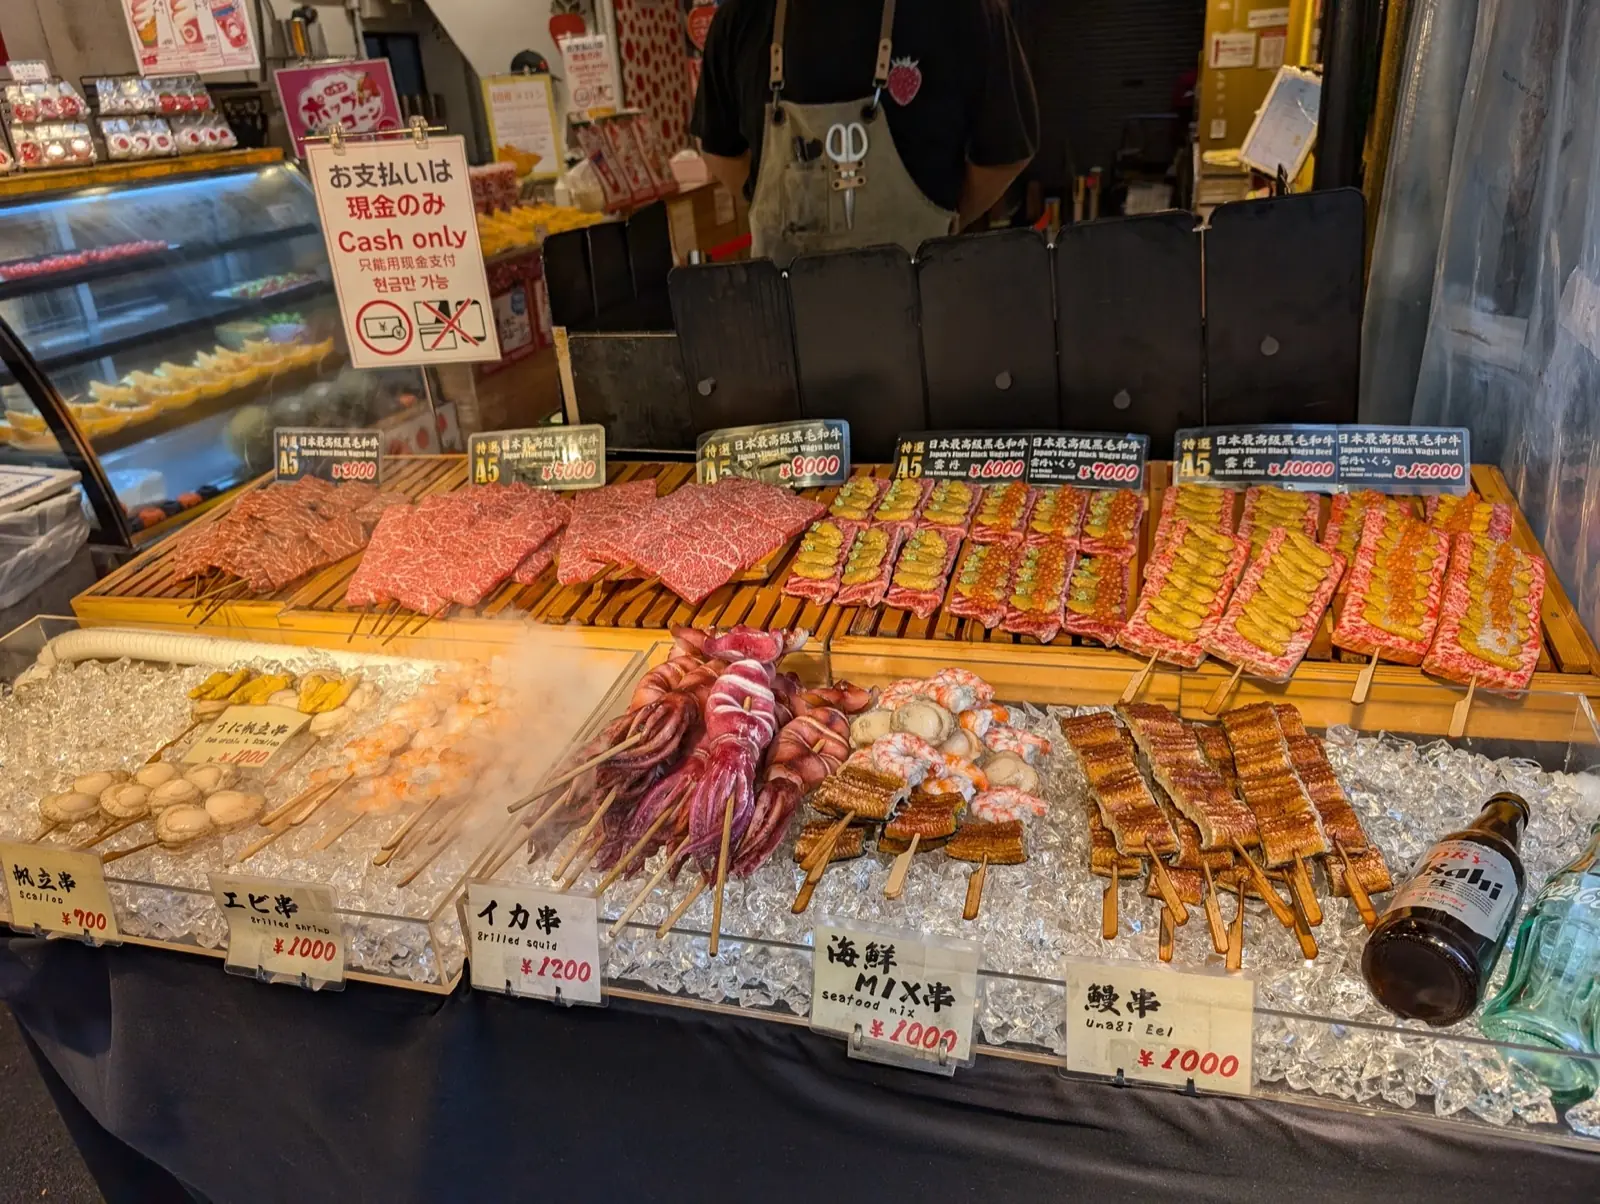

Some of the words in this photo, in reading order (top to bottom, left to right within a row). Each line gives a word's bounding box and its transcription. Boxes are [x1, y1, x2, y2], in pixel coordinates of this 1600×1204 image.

[329, 159, 453, 189] お支払いは
[346, 192, 446, 221] 現金のみ
[338, 227, 403, 253] Cash
[412, 225, 468, 249] only
[358, 253, 457, 272] 只能用现金支付
[372, 275, 416, 293] 현금만
[420, 274, 450, 290] 가능
[705, 443, 732, 458] 特選
[734, 427, 842, 451] 日本最高級黒毛和牛
[929, 437, 1028, 450] 日本最高級黒毛和牛
[1033, 437, 1141, 451] 日本最高級黒毛和牛
[1182, 437, 1212, 450] 特選
[1216, 434, 1336, 447] 日本最高級黒毛和牛
[1338, 433, 1461, 447] 日本最高級黒毛和牛
[279, 450, 299, 475] A5
[476, 457, 500, 483] A5
[896, 455, 923, 478] A5
[1180, 452, 1212, 477] A5
[13, 864, 76, 893] 帆立串
[223, 891, 299, 919] エビ串
[477, 900, 561, 935] イカ串
[526, 939, 557, 951] squid
[826, 935, 898, 975] 海鮮
[822, 990, 880, 1011] seafood
[889, 1005, 915, 1018] mix
[855, 972, 956, 1013] MIX串
[1084, 983, 1162, 1019] 鰻串
[1146, 1024, 1173, 1038] Eel
[1137, 1048, 1239, 1078] ¥1000
